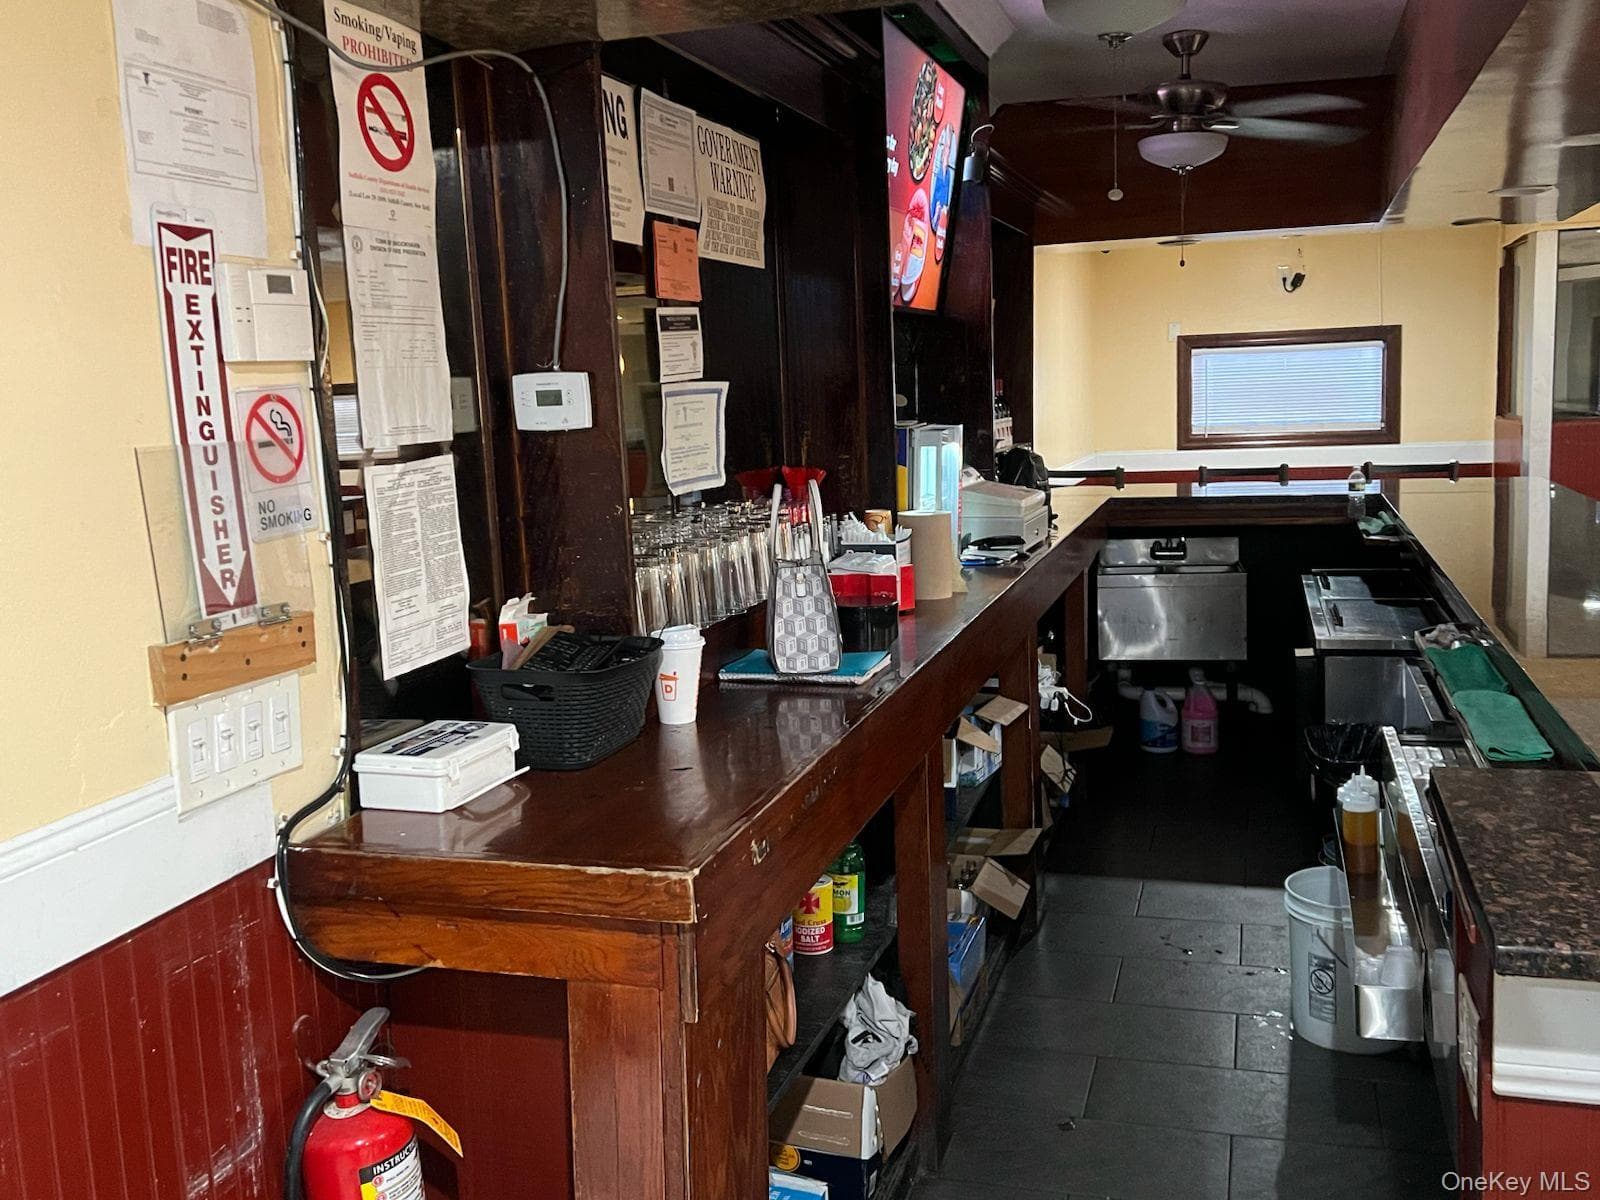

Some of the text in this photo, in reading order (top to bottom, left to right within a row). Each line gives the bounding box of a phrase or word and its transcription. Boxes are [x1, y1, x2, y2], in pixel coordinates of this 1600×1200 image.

[333, 8, 417, 54] Smoking/Vaping
[697, 125, 761, 176] GOVERNMENT
[165, 246, 213, 286] FIRE
[185, 293, 236, 588] EXTINGUISHER
[258, 499, 275, 514] NO
[260, 508, 311, 530] SMOKING
[664, 684, 673, 694] D
[800, 935, 820, 943] SALT
